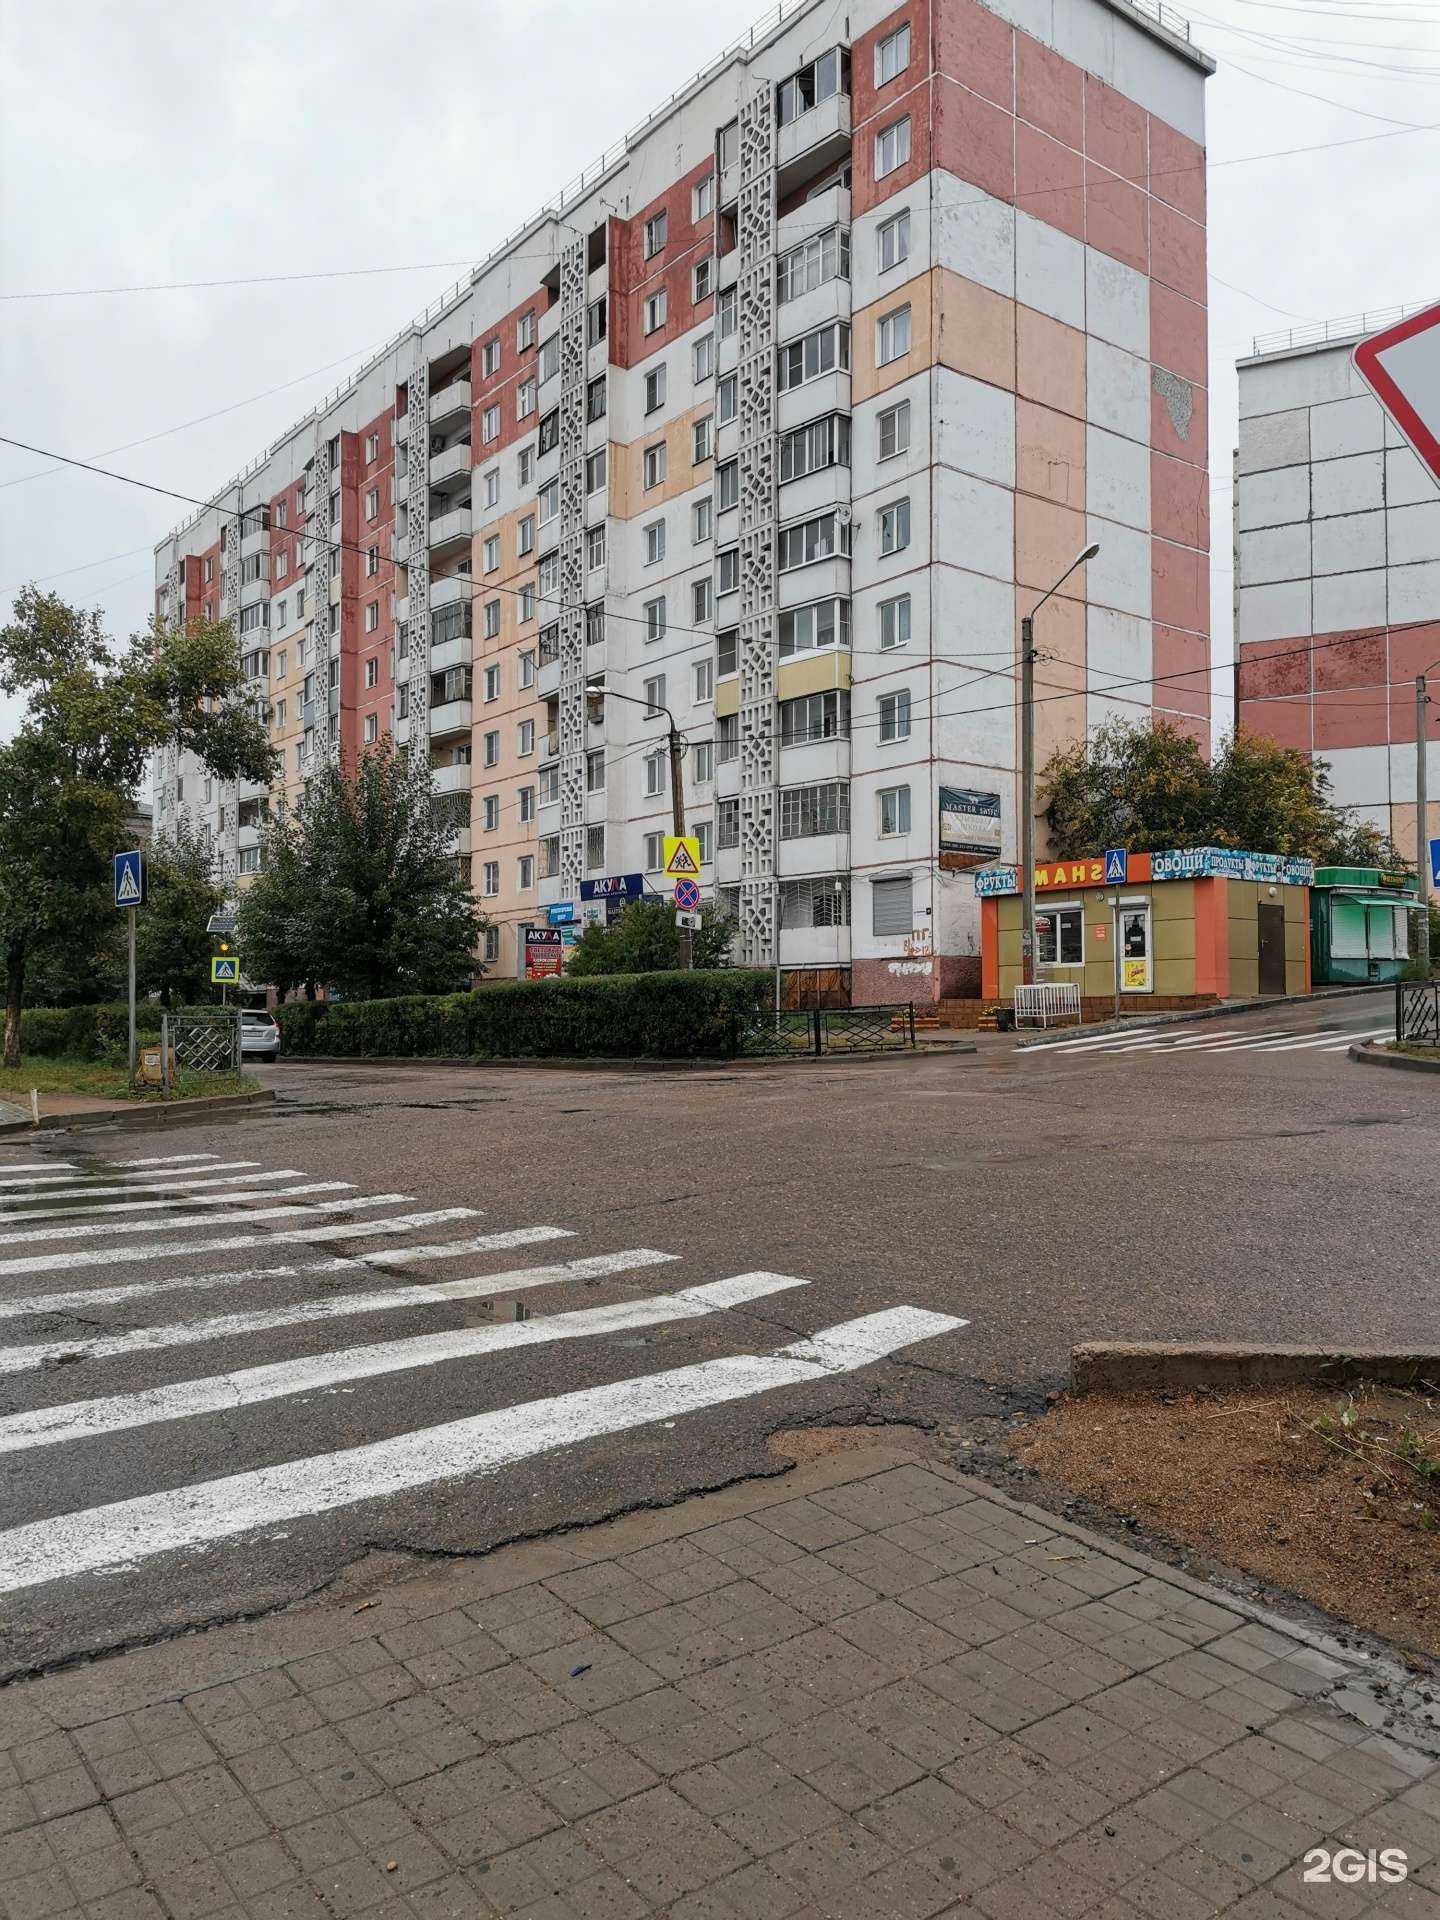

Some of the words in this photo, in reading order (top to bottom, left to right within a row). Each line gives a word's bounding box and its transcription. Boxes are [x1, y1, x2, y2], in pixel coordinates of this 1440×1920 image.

[1154, 854, 1204, 872] ОВОЩИ
[1211, 855, 1245, 870] ПРОДУКТЫ
[975, 873, 1017, 891] ФРУКТЫ
